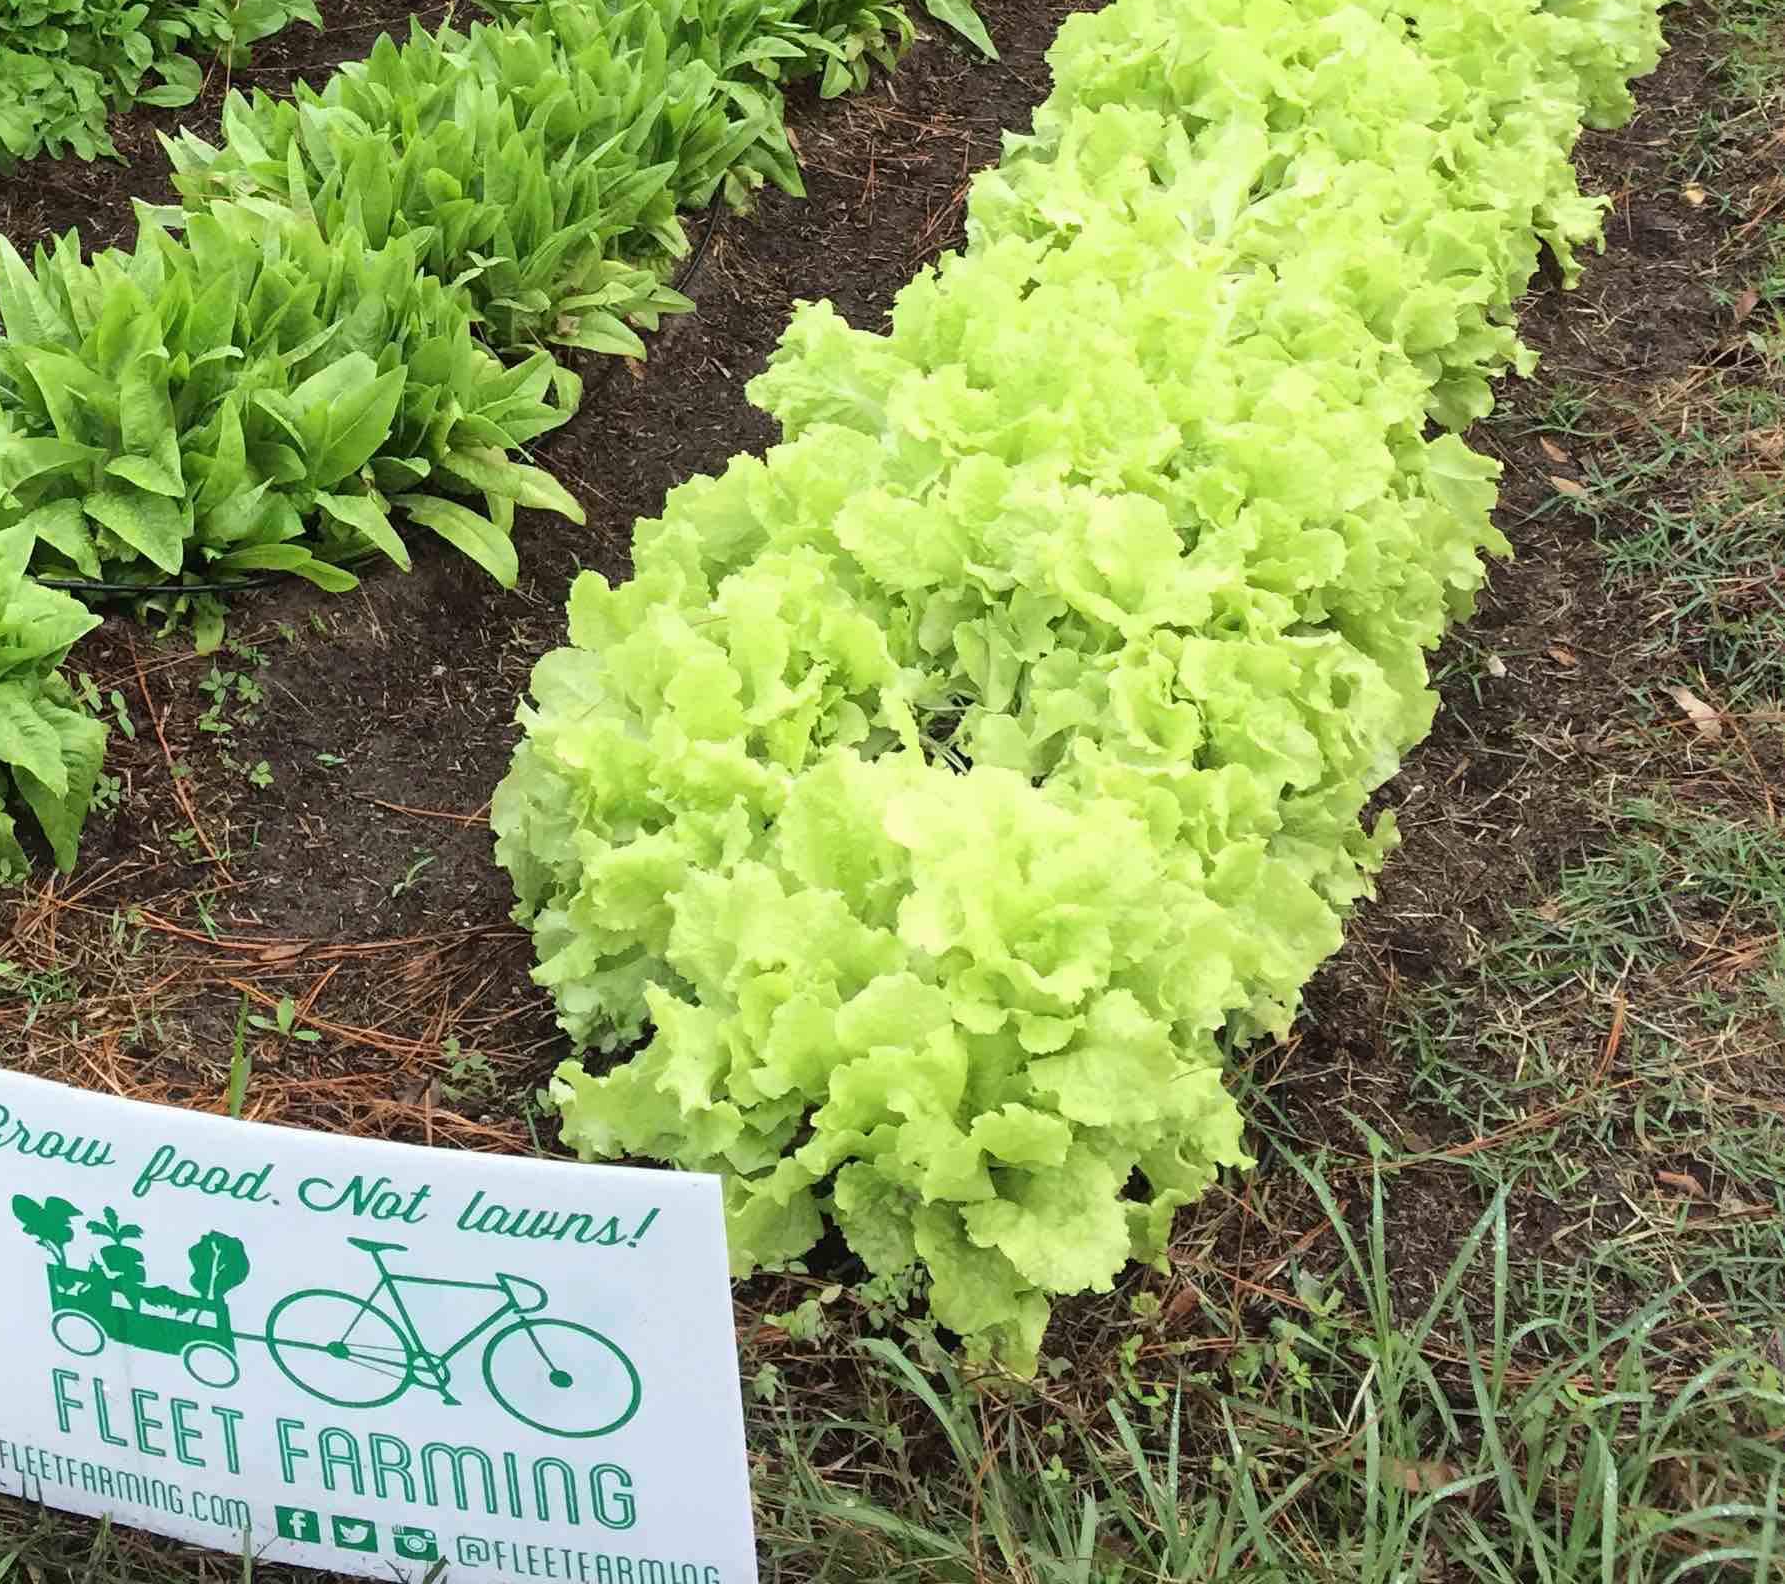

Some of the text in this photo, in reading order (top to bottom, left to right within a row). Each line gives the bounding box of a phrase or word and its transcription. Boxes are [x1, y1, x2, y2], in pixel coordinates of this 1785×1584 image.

[131, 1144, 281, 1206] food.
[297, 1174, 432, 1224] Not
[455, 1190, 661, 1249] lawns!
[51, 1367, 637, 1531] FLEET FARMING
